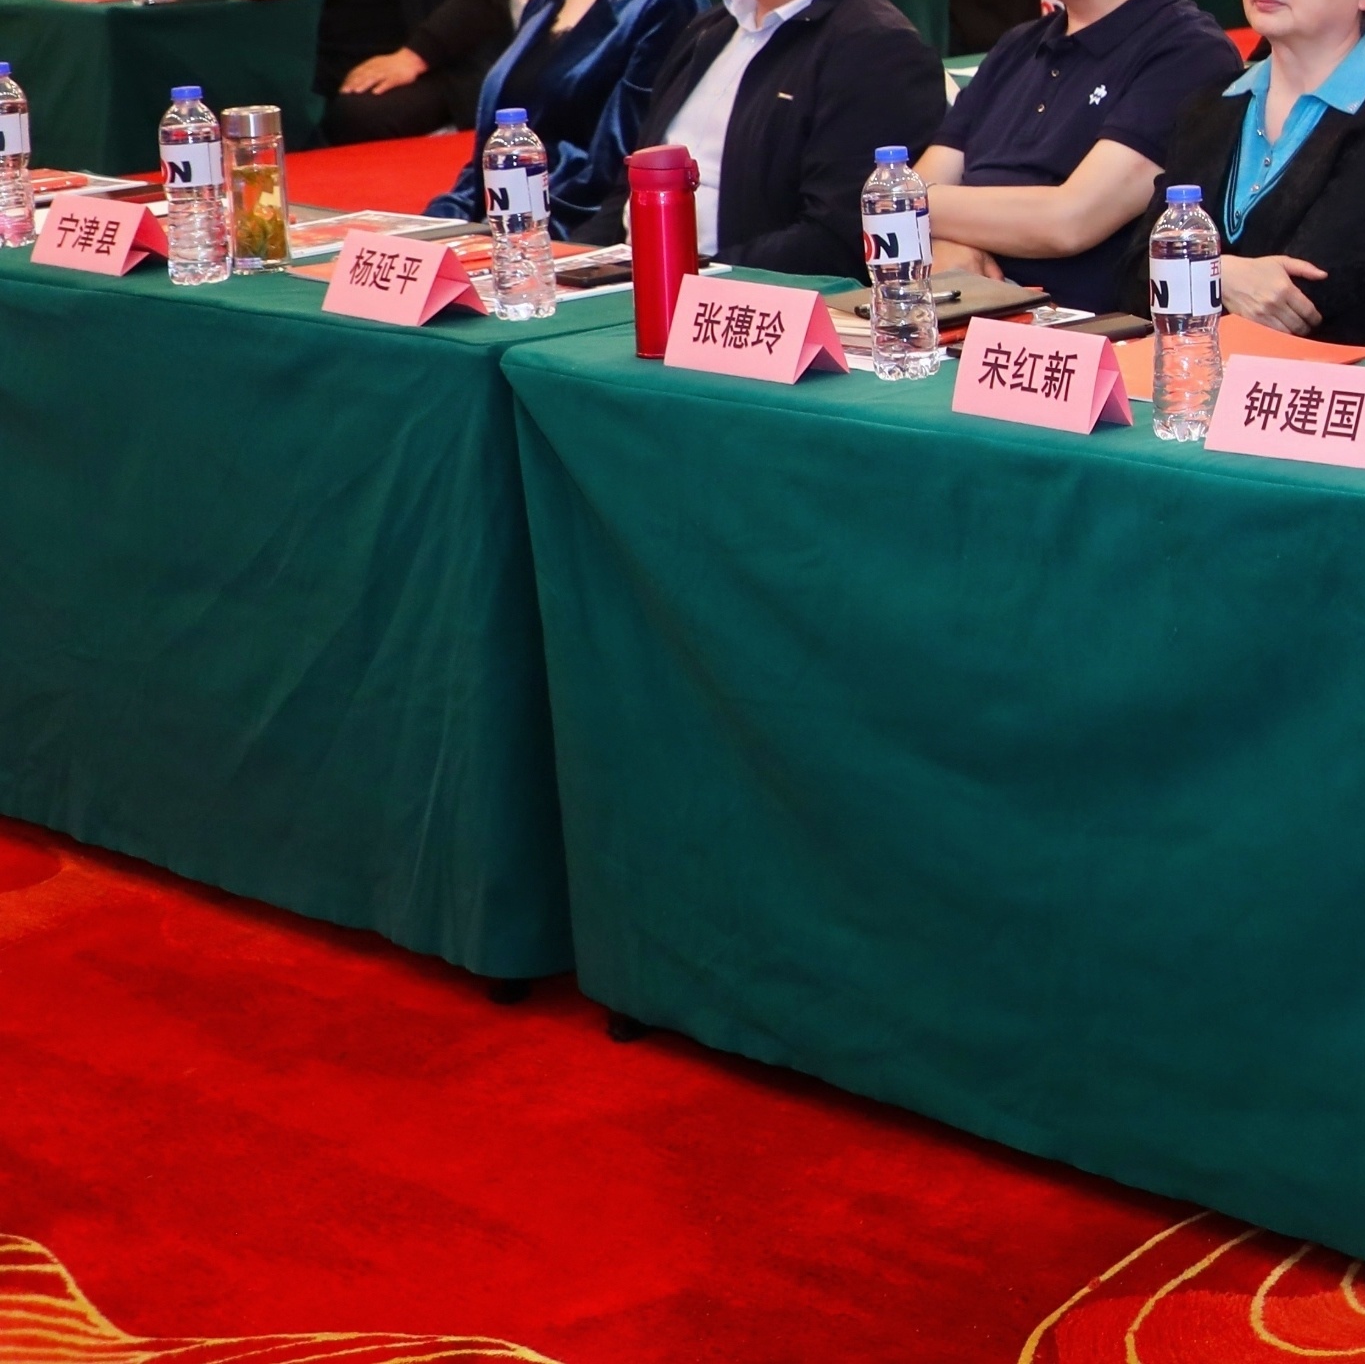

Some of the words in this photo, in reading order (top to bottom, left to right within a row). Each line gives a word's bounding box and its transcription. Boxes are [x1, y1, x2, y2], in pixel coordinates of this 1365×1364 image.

[56, 213, 121, 256] 宁津县
[350, 247, 423, 295] 杨延平
[692, 302, 785, 355] 张穗玲
[978, 342, 1078, 402] 宋红新
[1243, 381, 1365, 441] 钟建国
